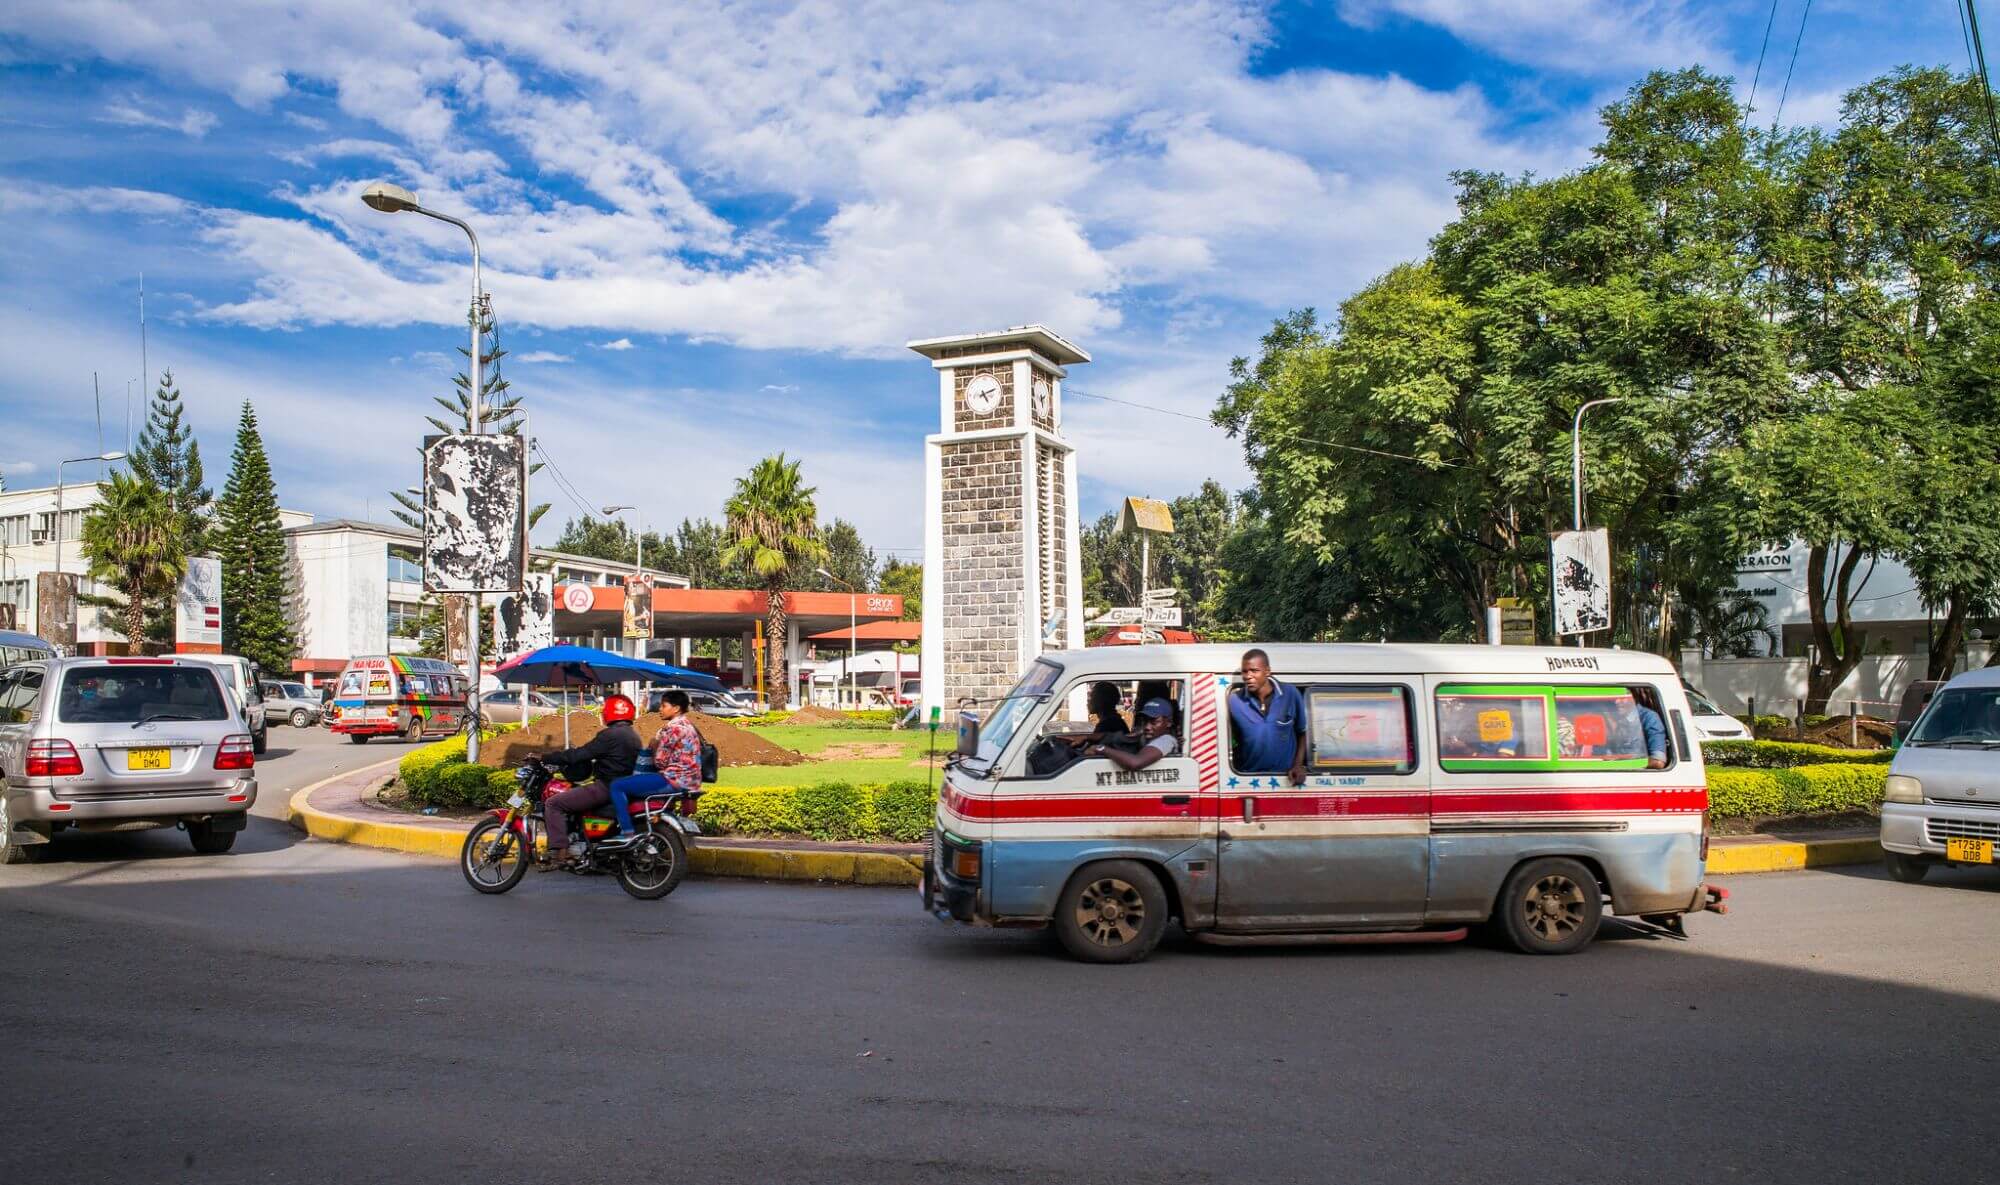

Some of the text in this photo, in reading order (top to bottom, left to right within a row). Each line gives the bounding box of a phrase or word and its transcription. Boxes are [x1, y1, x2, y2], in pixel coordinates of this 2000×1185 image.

[1736, 555, 1791, 567] ERATON
[1754, 587, 1777, 596] Hotel
[867, 598, 894, 607] ORYX
[1545, 656, 1600, 671] HOMEBOY
[1096, 768, 1180, 786] MY BEAUTIFIER
[1958, 840, 1981, 850] T758
